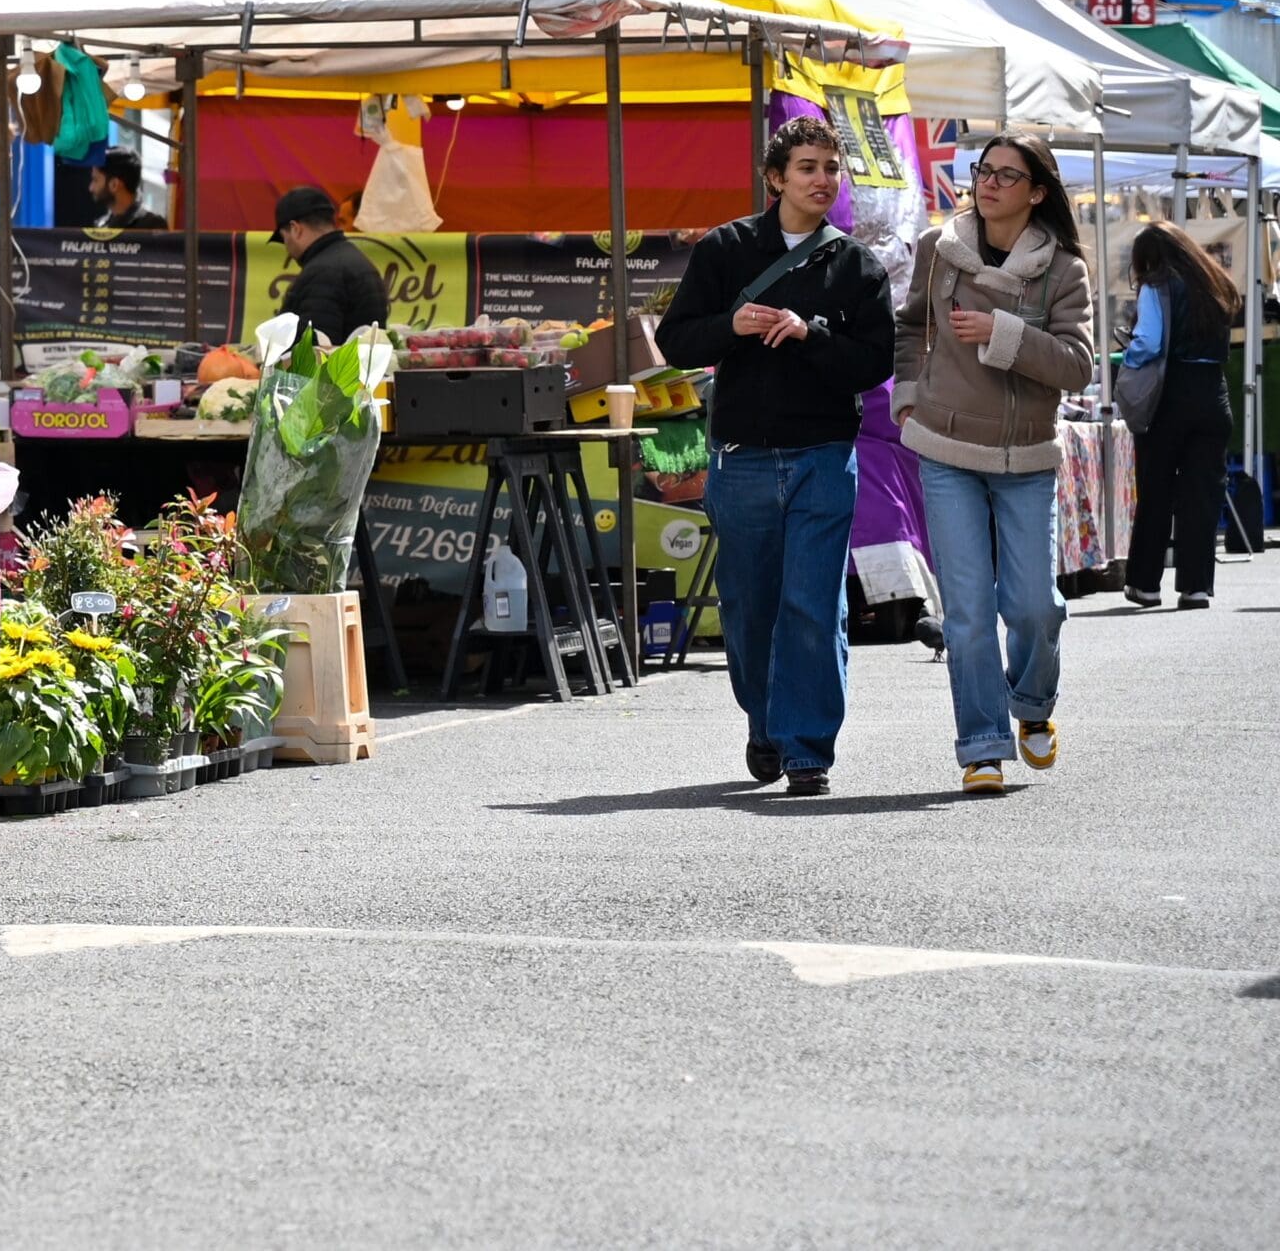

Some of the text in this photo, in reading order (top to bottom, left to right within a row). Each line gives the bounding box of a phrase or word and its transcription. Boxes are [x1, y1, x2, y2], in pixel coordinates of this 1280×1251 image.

[1091, 4, 1151, 22] GUS
[109, 243, 141, 254] WRAP
[626, 258, 659, 270] WRAP
[485, 273, 499, 282] THE
[571, 276, 595, 284] WRAP
[484, 289, 509, 298] LARGE
[511, 290, 534, 298] WRAP
[484, 304, 519, 313] REGULAR
[520, 305, 543, 314] WRAP
[32, 412, 109, 429] TOROSOL
[363, 493, 413, 512] ystem
[419, 494, 478, 520] Defeat
[666, 534, 693, 550] Vegan
